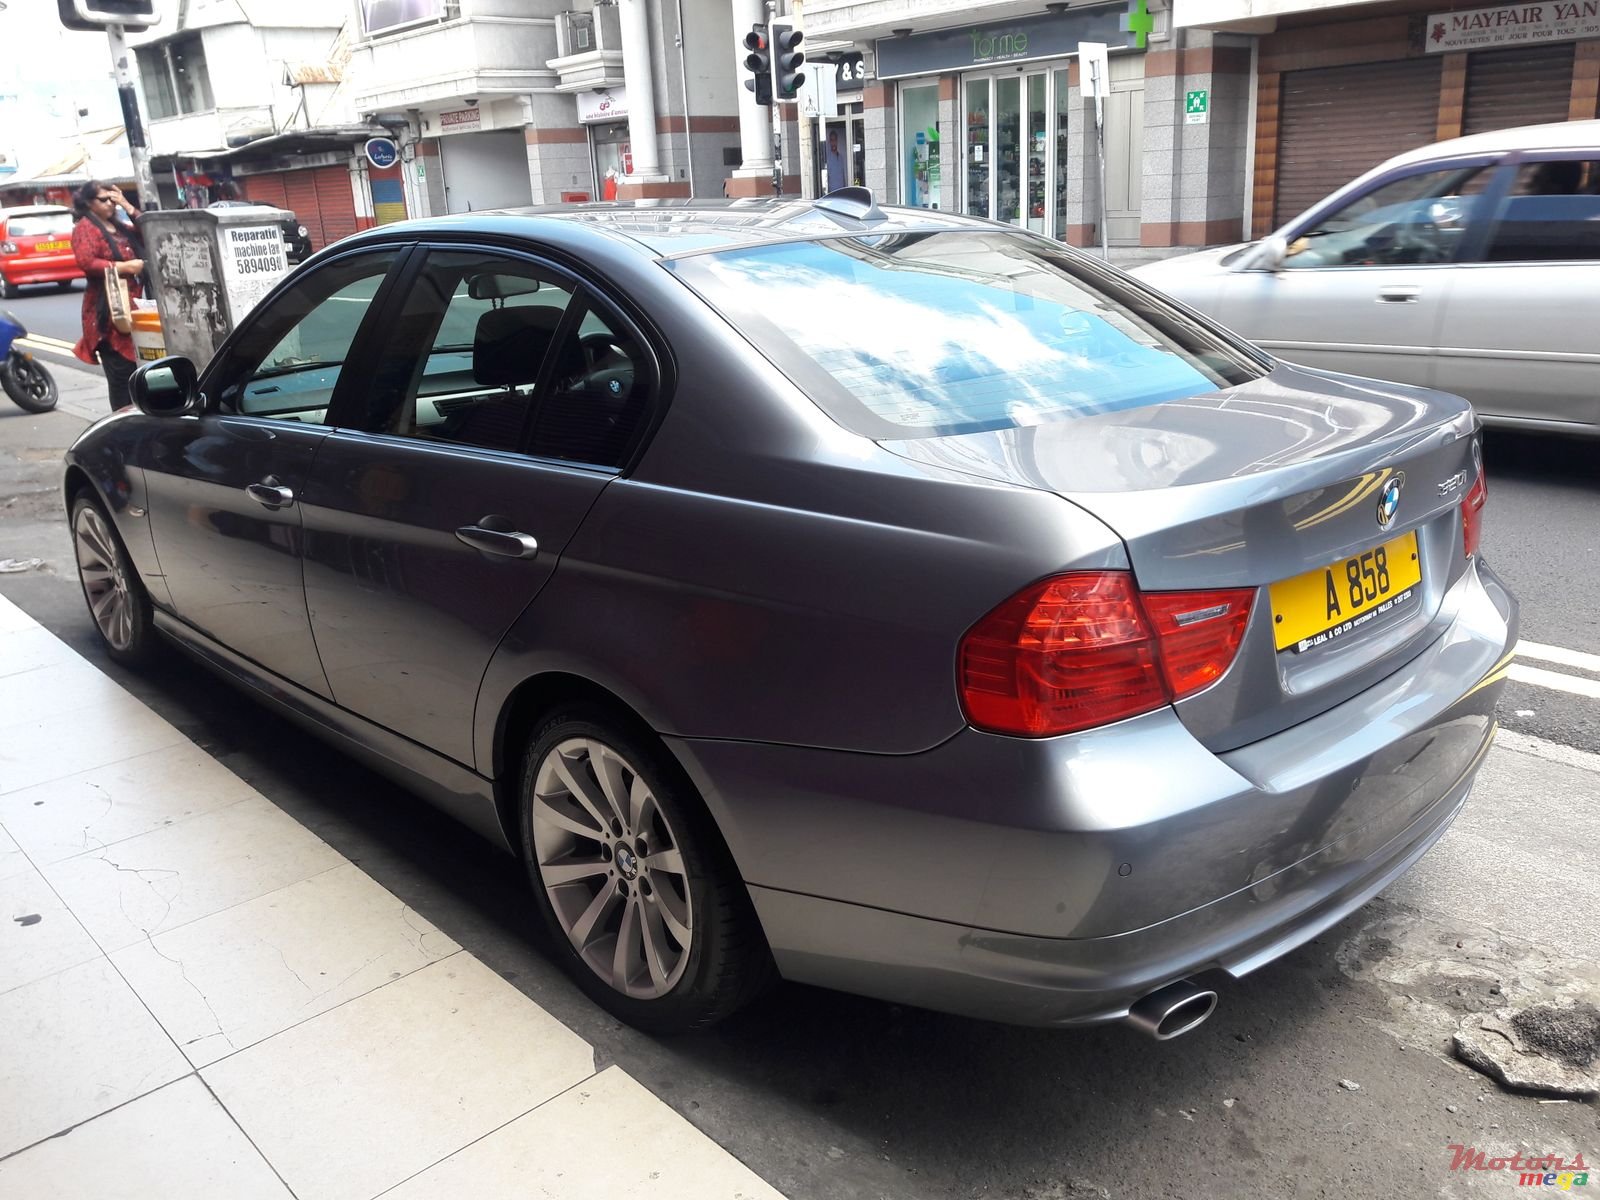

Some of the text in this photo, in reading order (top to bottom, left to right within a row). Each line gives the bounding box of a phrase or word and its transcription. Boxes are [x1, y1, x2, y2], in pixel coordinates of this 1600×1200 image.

[1452, 7, 1543, 31] MAYFAIR
[1553, 1, 1599, 21] YAN
[1494, 34, 1505, 42] DU
[1508, 32, 1528, 40] JOUR
[1533, 29, 1553, 38] POUR
[1557, 27, 1577, 36] TOUS
[842, 62, 852, 81] &
[440, 110, 480, 125] PRIVATE PARKING
[234, 243, 268, 258] machine
[1326, 546, 1390, 621] A 858
[1314, 633, 1328, 645] LEAL
[1328, 630, 1334, 639] &
[1334, 626, 1343, 636] CO
[1343, 622, 1352, 632] LTD
